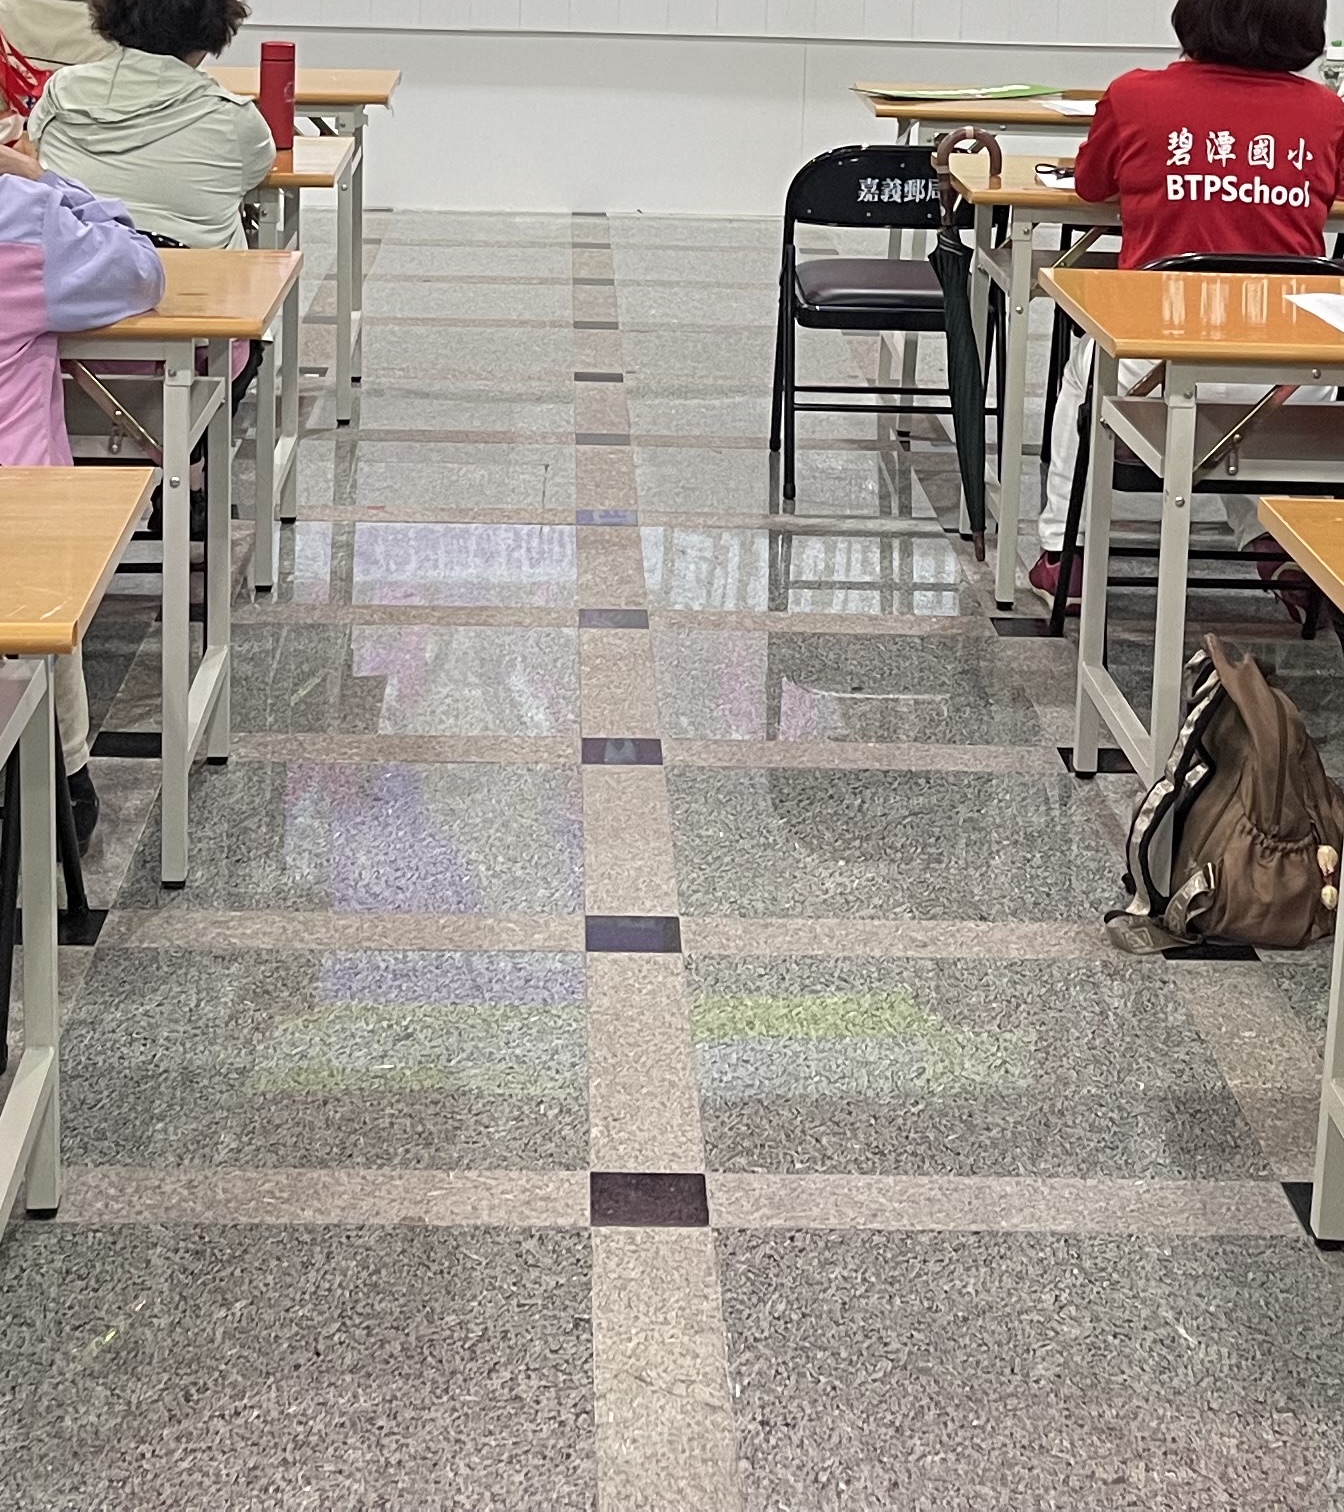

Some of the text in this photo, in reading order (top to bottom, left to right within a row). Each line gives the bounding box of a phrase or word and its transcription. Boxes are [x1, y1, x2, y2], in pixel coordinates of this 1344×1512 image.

[1166, 126, 1313, 171] 碧潭國小
[1166, 174, 1310, 208] BTPSchool
